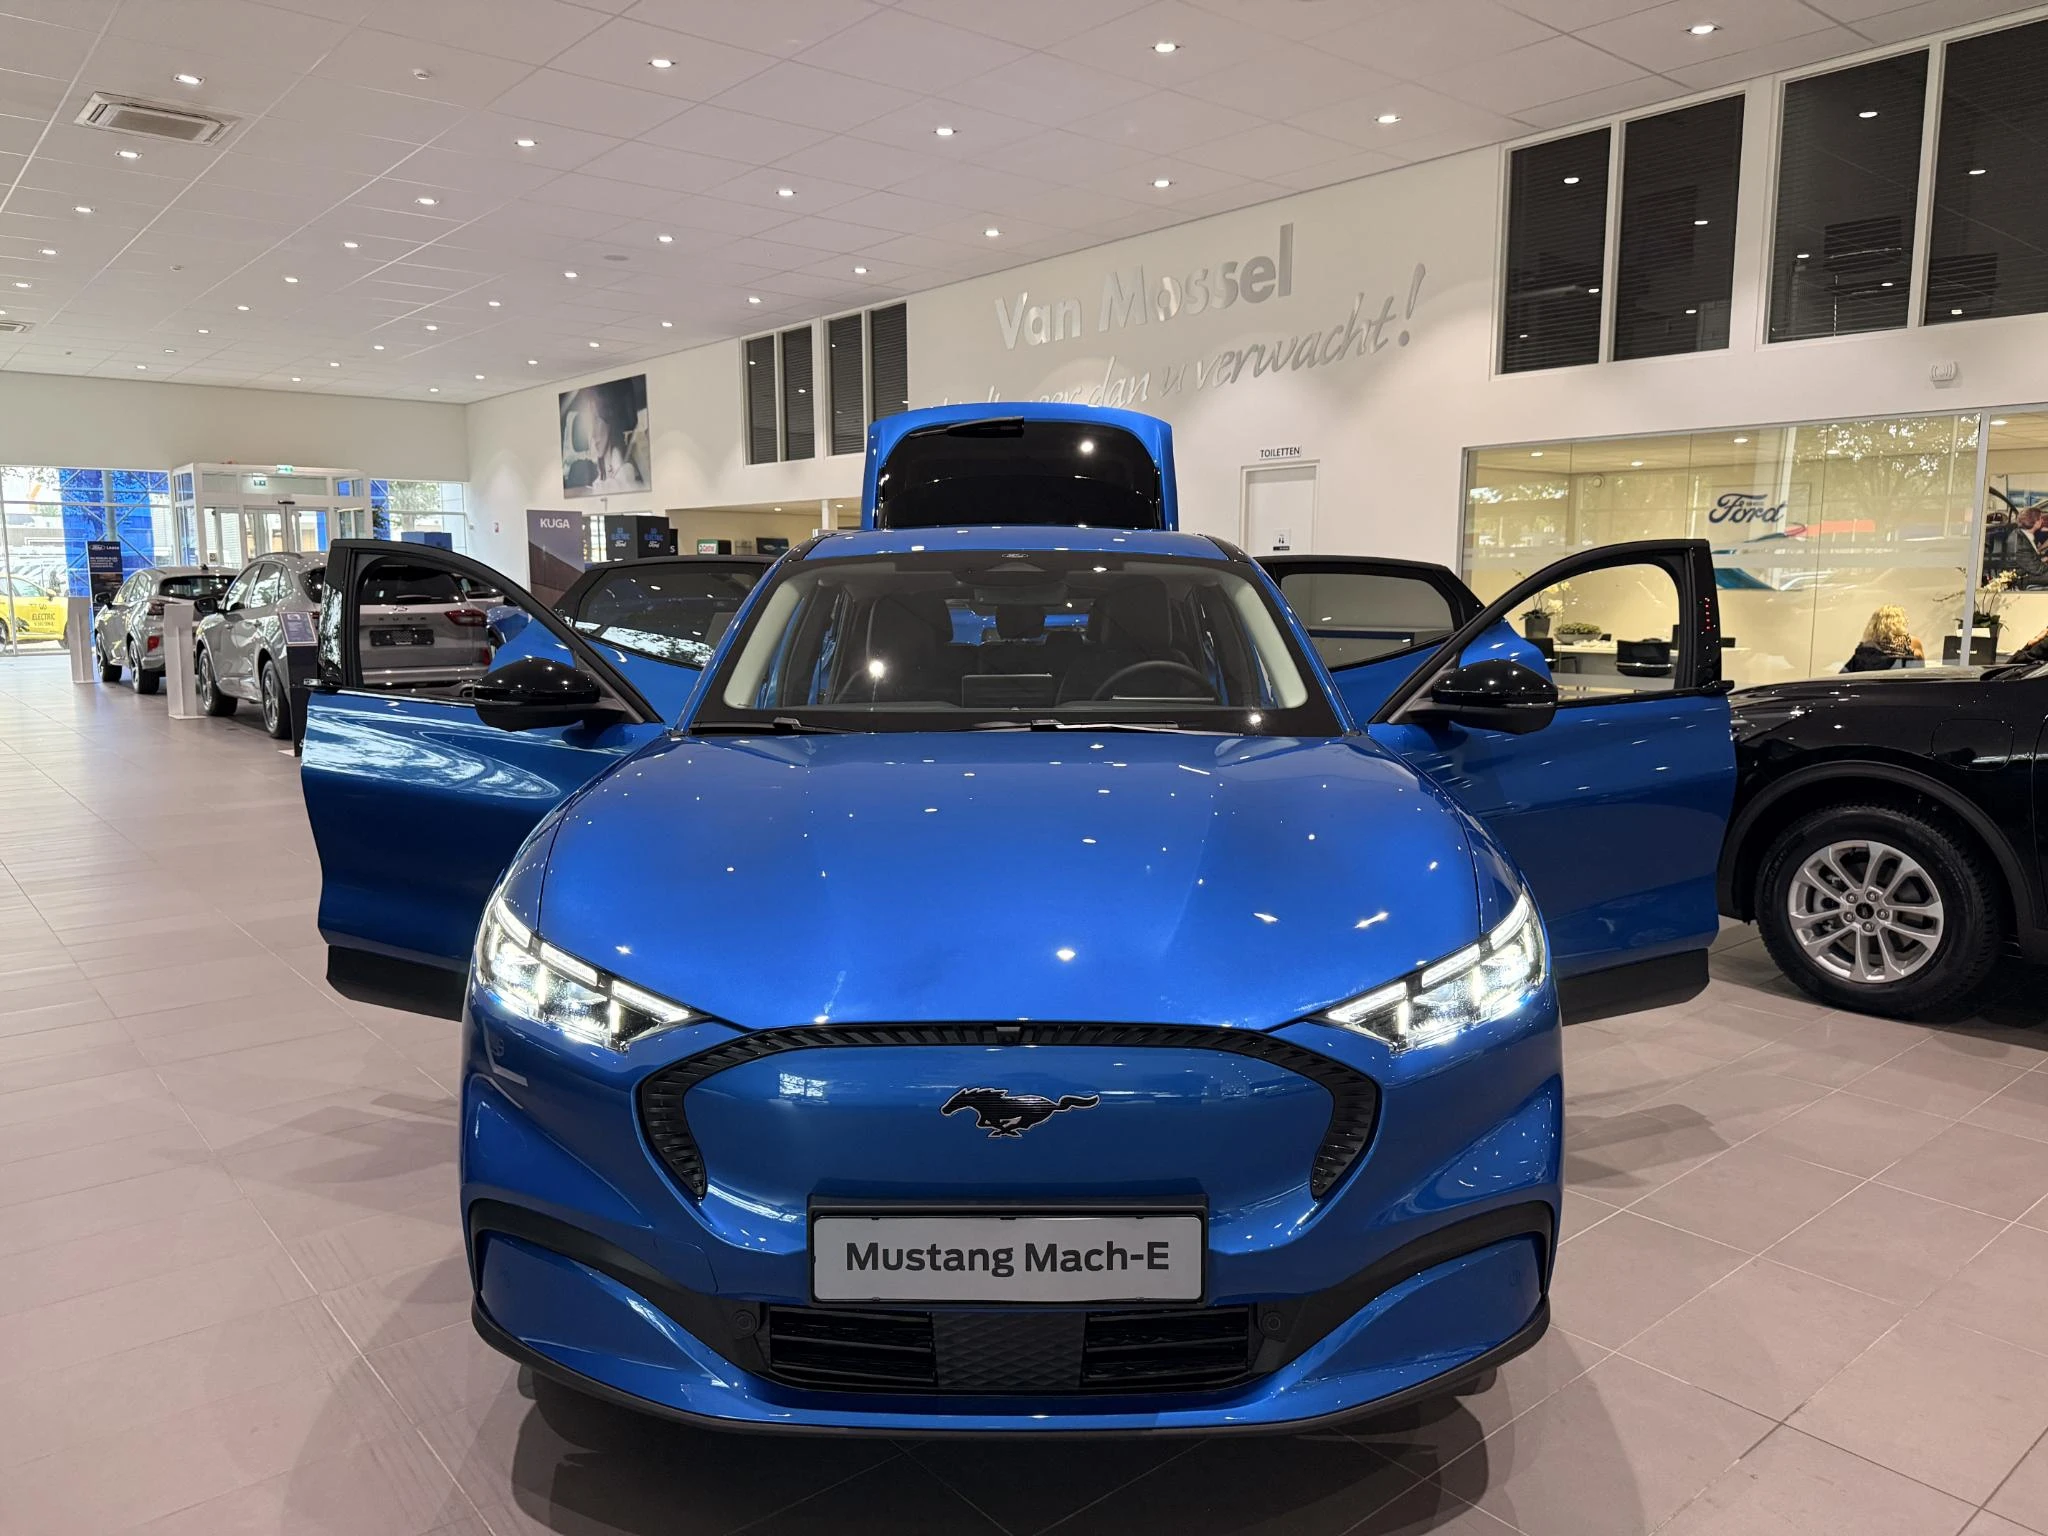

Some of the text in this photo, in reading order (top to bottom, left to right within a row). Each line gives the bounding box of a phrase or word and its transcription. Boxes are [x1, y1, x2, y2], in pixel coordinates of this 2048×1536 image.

[995, 222, 1293, 350] Van Mossel
[1087, 355, 1150, 407] dan
[1196, 263, 1426, 391] verwacht!
[1260, 447, 1300, 458] TOILETTEN
[540, 518, 570, 528] KUGA
[1709, 493, 1786, 523] Ford
[846, 1241, 1169, 1277] Mustang Mach-E
